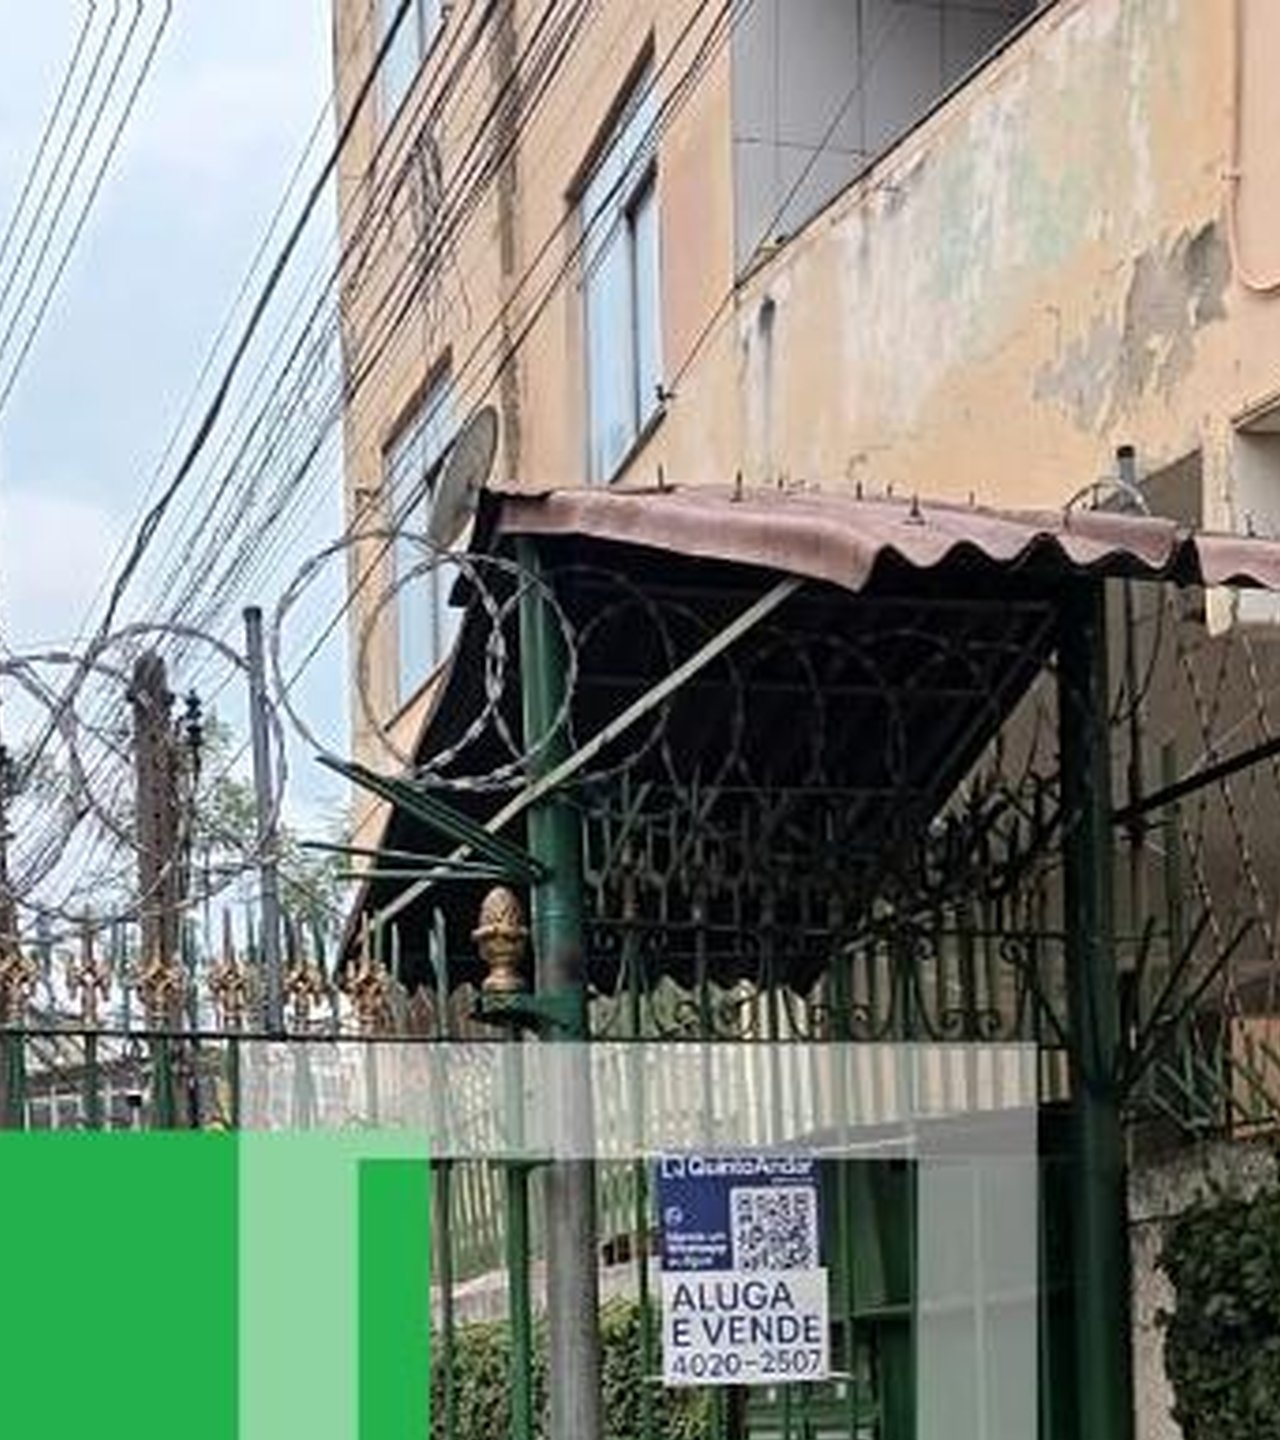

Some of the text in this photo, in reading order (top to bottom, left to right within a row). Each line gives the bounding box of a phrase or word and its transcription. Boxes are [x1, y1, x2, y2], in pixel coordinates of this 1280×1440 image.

[672, 1282, 795, 1311] ALUGA
[672, 1316, 821, 1347] E VENDE
[672, 1350, 821, 1378] 4020-2507
